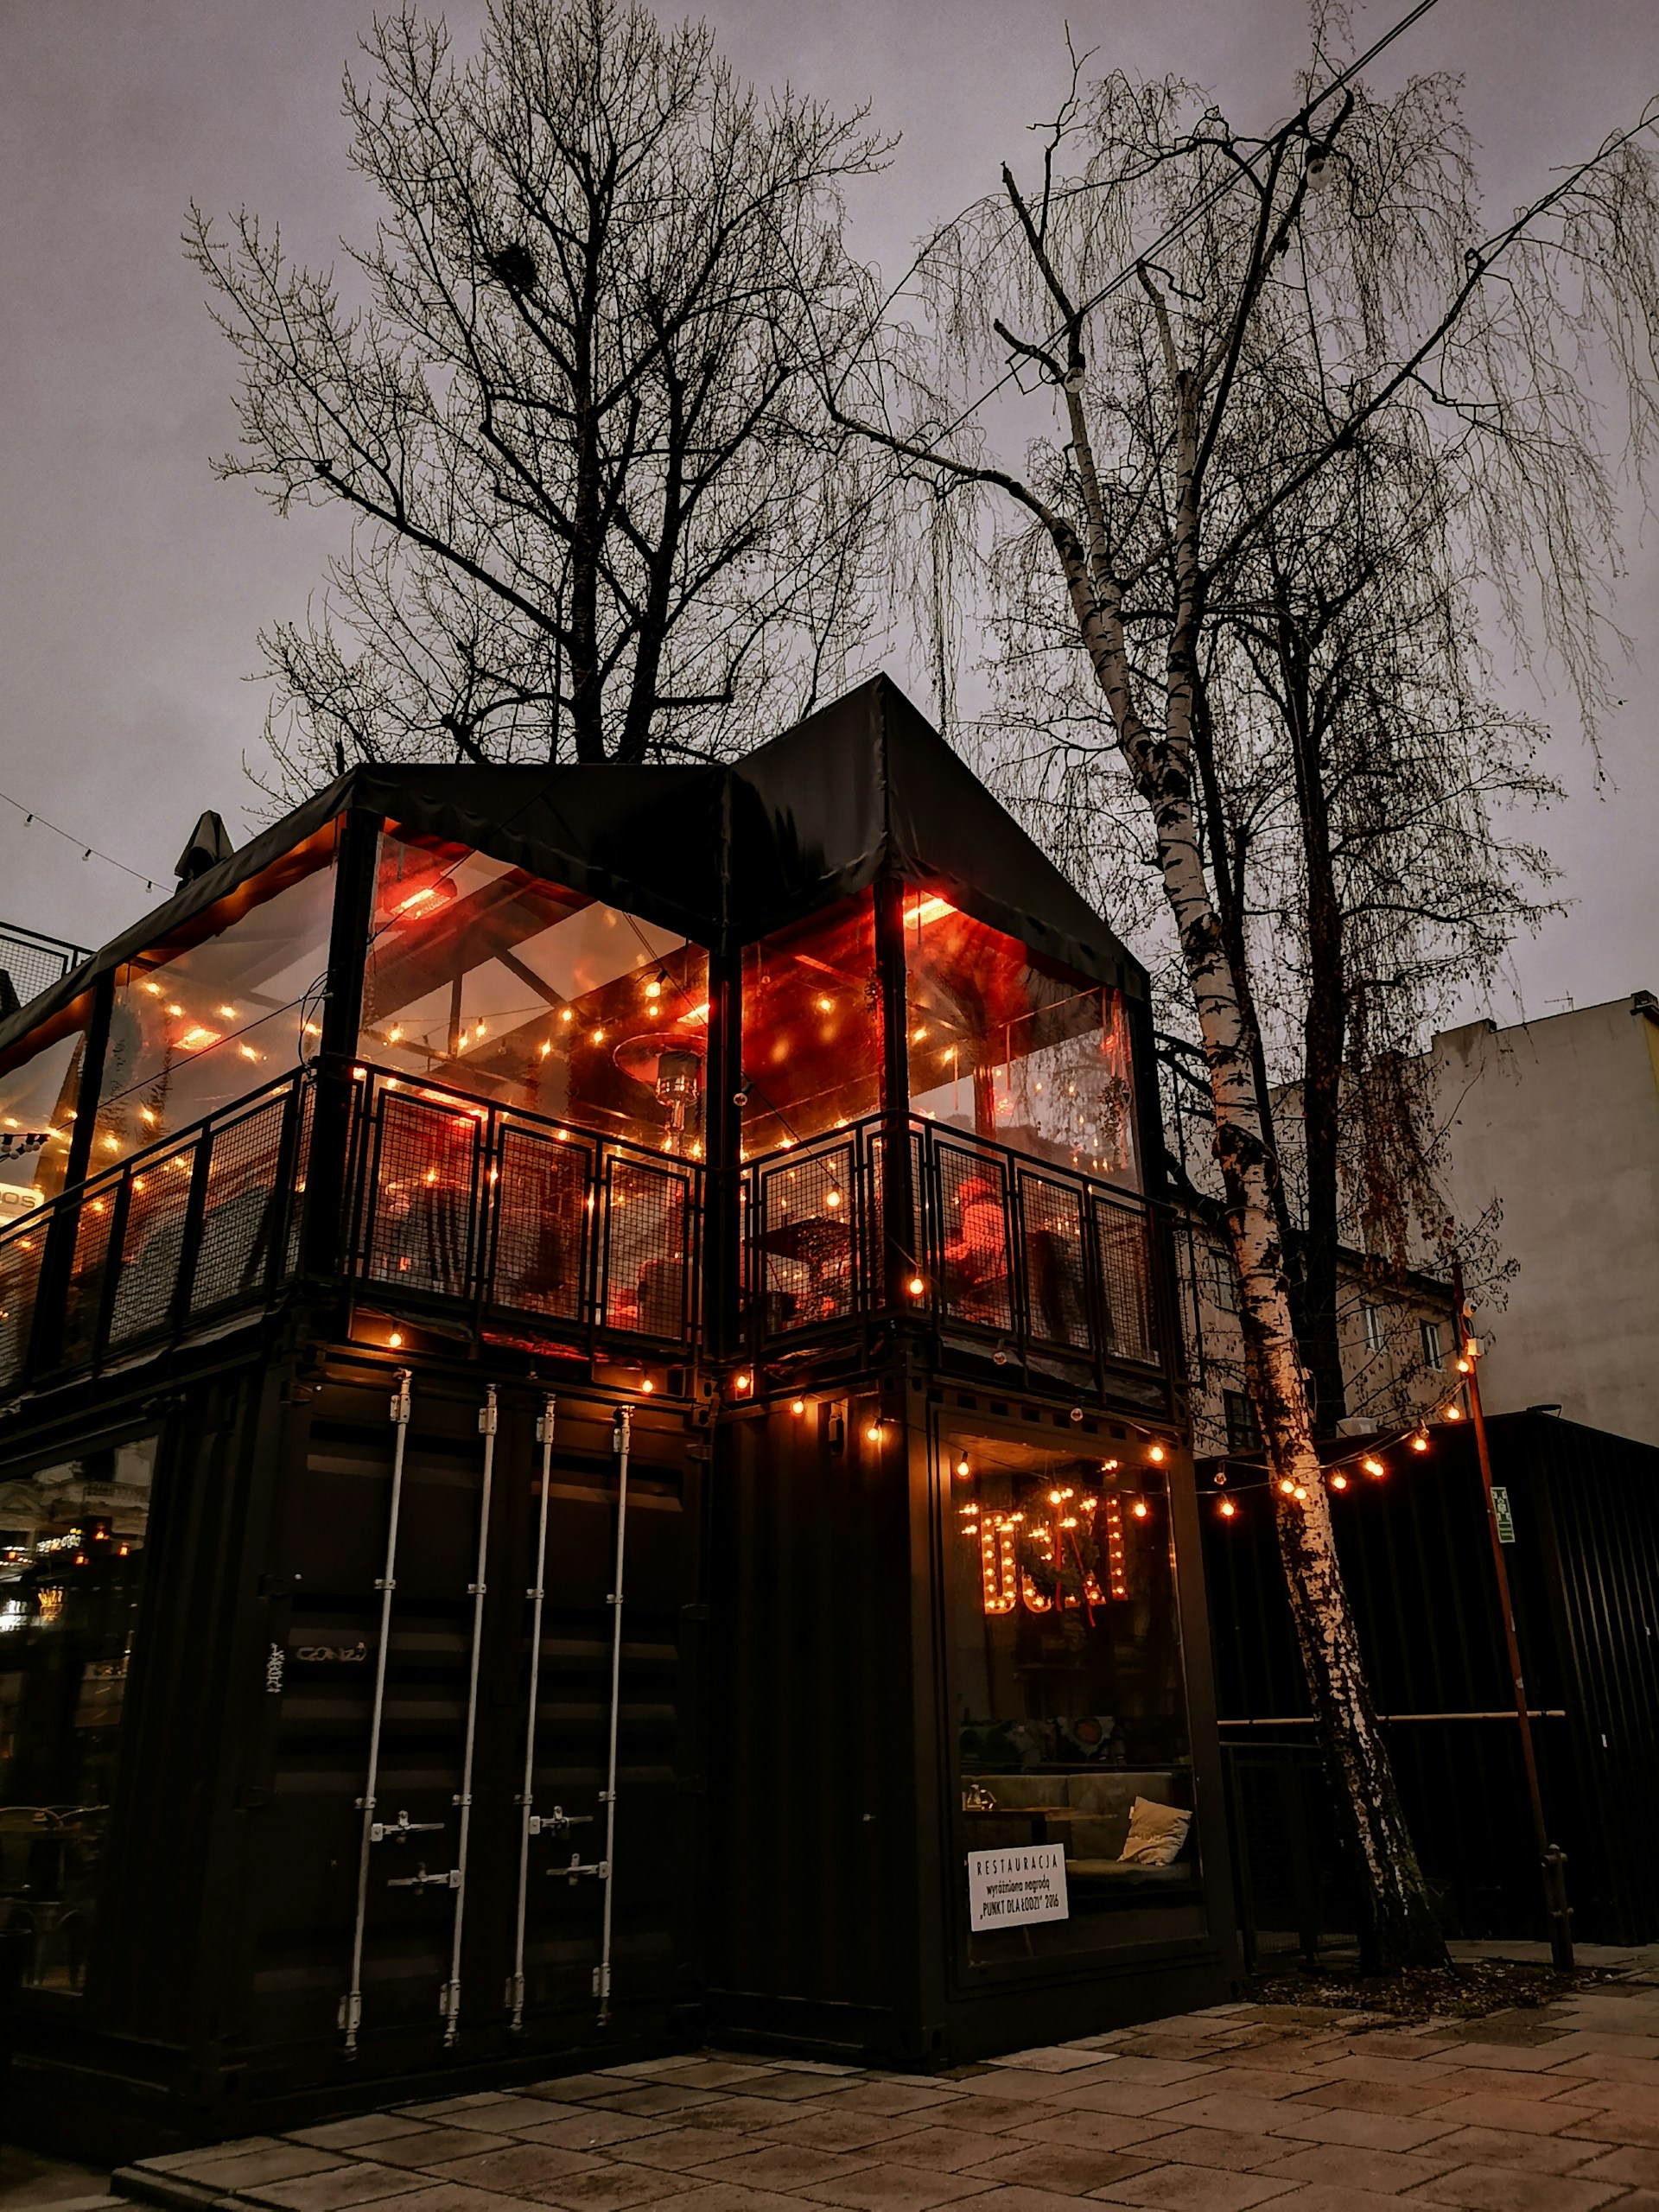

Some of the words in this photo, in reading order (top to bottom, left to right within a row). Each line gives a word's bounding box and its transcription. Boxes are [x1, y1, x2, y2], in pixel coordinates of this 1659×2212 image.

[0, 1192, 35, 1209] OS
[976, 1853, 1058, 1876] RESTAURACJA
[1024, 1874, 1050, 1893] nagrodą
[1007, 1898, 1020, 1914] DLA
[1045, 1893, 1059, 1909] 2016
